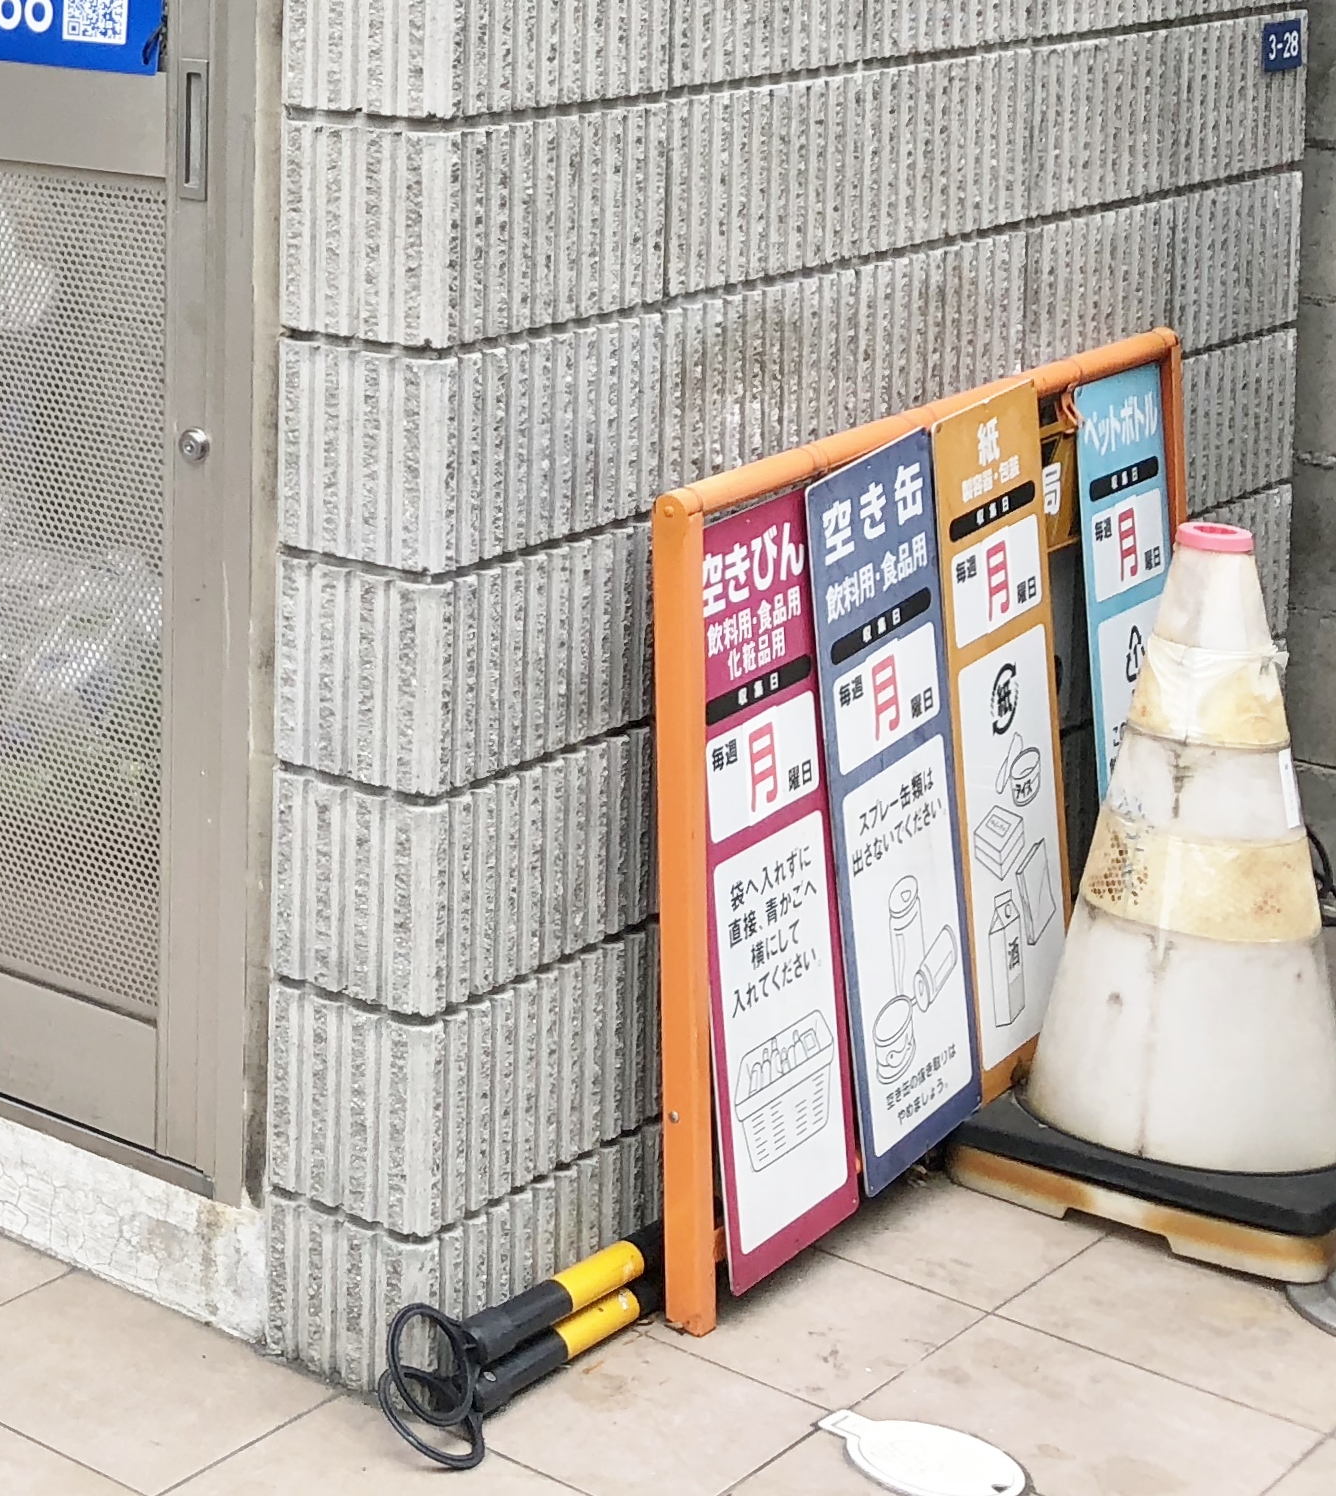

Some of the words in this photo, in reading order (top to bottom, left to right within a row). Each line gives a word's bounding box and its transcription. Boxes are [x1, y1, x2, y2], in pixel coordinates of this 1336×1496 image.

[1268, 30, 1299, 61] 3-28
[976, 416, 1001, 468] 紙
[1083, 389, 1159, 457] ペットボトル
[821, 461, 924, 567] 空き缶
[1094, 516, 1113, 542] 毎週
[1118, 507, 1139, 582] 月
[703, 522, 805, 618] 空きびん
[825, 531, 928, 625] 飲料用・食品用
[955, 554, 978, 585] 毎週
[986, 539, 1011, 622] 月
[1016, 575, 1037, 605] 曜日
[707, 585, 802, 658] 飲料用・食品用
[728, 626, 786, 681] 化粧品用
[839, 673, 864, 708] 毎週
[871, 653, 901, 742] 月
[910, 686, 935, 720] 曜日
[996, 677, 1013, 718] 紙
[710, 738, 739, 772] 毎週
[748, 721, 779, 813] 月
[787, 758, 813, 793] 曜日
[859, 767, 934, 836] スプレー缶類は
[730, 845, 812, 912] 袋へ入れずに
[728, 879, 818, 949] 直接、青かごへ
[750, 918, 800, 971] 横にして
[886, 1042, 957, 1111] 空き缶の抜き取りは
[897, 1077, 948, 1126] やめましょう。
